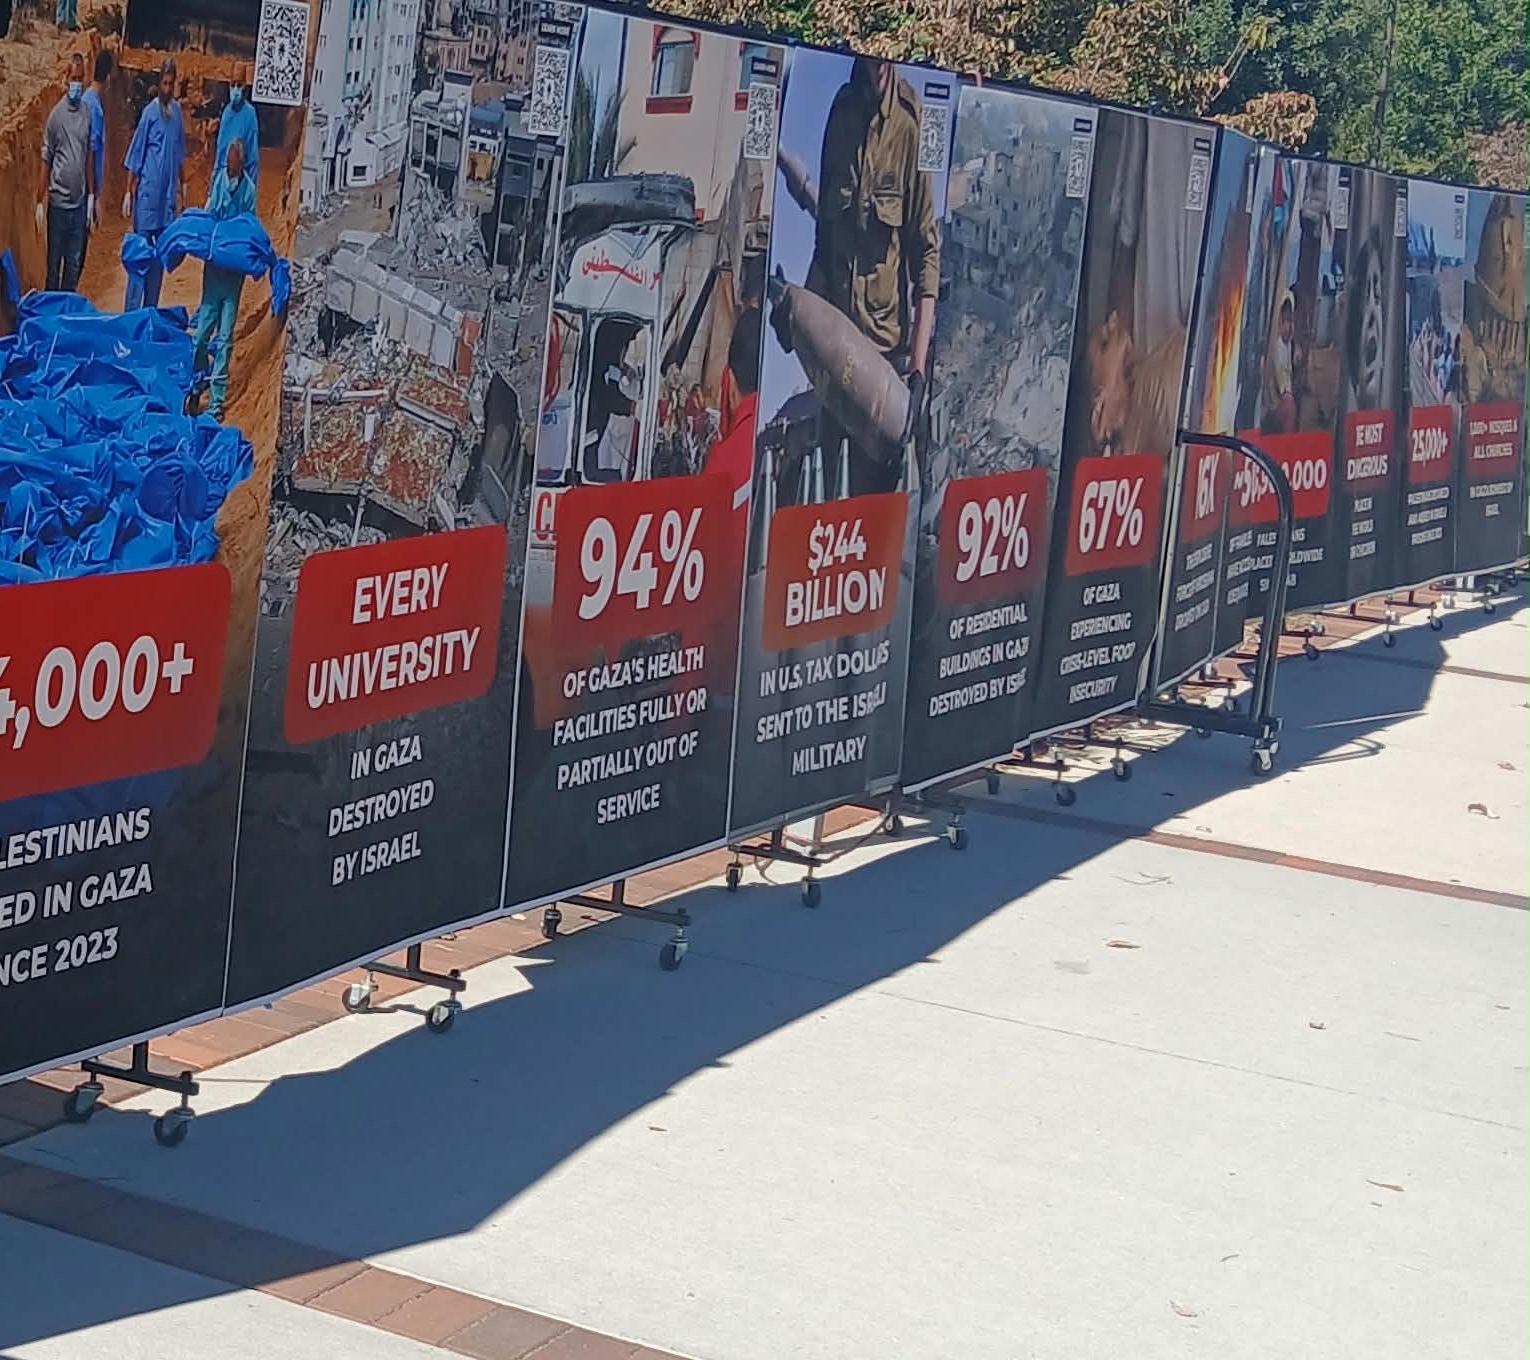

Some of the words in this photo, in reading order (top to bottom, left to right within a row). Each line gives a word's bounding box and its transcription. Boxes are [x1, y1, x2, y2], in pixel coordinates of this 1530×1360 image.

[955, 493, 1029, 583] 92%
[1079, 478, 1144, 553] 67%
[578, 507, 705, 620] 94%
[808, 519, 867, 576] $244
[351, 562, 450, 625] EVERY
[785, 567, 887, 627] BILLION
[950, 617, 965, 640] OF
[966, 603, 1028, 635] RESIDENTIAL
[306, 627, 481, 709] UNIVERSITY
[563, 672, 588, 698] OF
[588, 658, 646, 694] GAZA'S
[647, 645, 704, 682] HEALTH
[760, 670, 776, 697] IN
[806, 655, 833, 684] TAX
[940, 646, 991, 679] BUILDINGS
[992, 642, 1004, 663] IN
[553, 699, 636, 747] FACILITIES
[638, 692, 685, 728] FULLY
[686, 687, 707, 713] OR
[757, 709, 793, 743] SENT
[795, 704, 812, 731] TO
[816, 696, 849, 725] THE
[930, 682, 988, 716] DESTROYED
[990, 677, 1005, 699] BY
[349, 749, 370, 781] IN
[373, 734, 423, 774] GAZA
[557, 744, 642, 791] PARTIALLY
[645, 736, 675, 765] OUT
[677, 730, 699, 758] OF
[792, 736, 866, 775] MILITARY
[327, 778, 435, 838] DESTROYED
[597, 783, 661, 825] SERVICE
[331, 854, 360, 886] BY
[360, 831, 421, 875] ISRAEL
[43, 881, 74, 919] IN
[80, 863, 153, 910] GAZA
[53, 926, 119, 977] 2023
